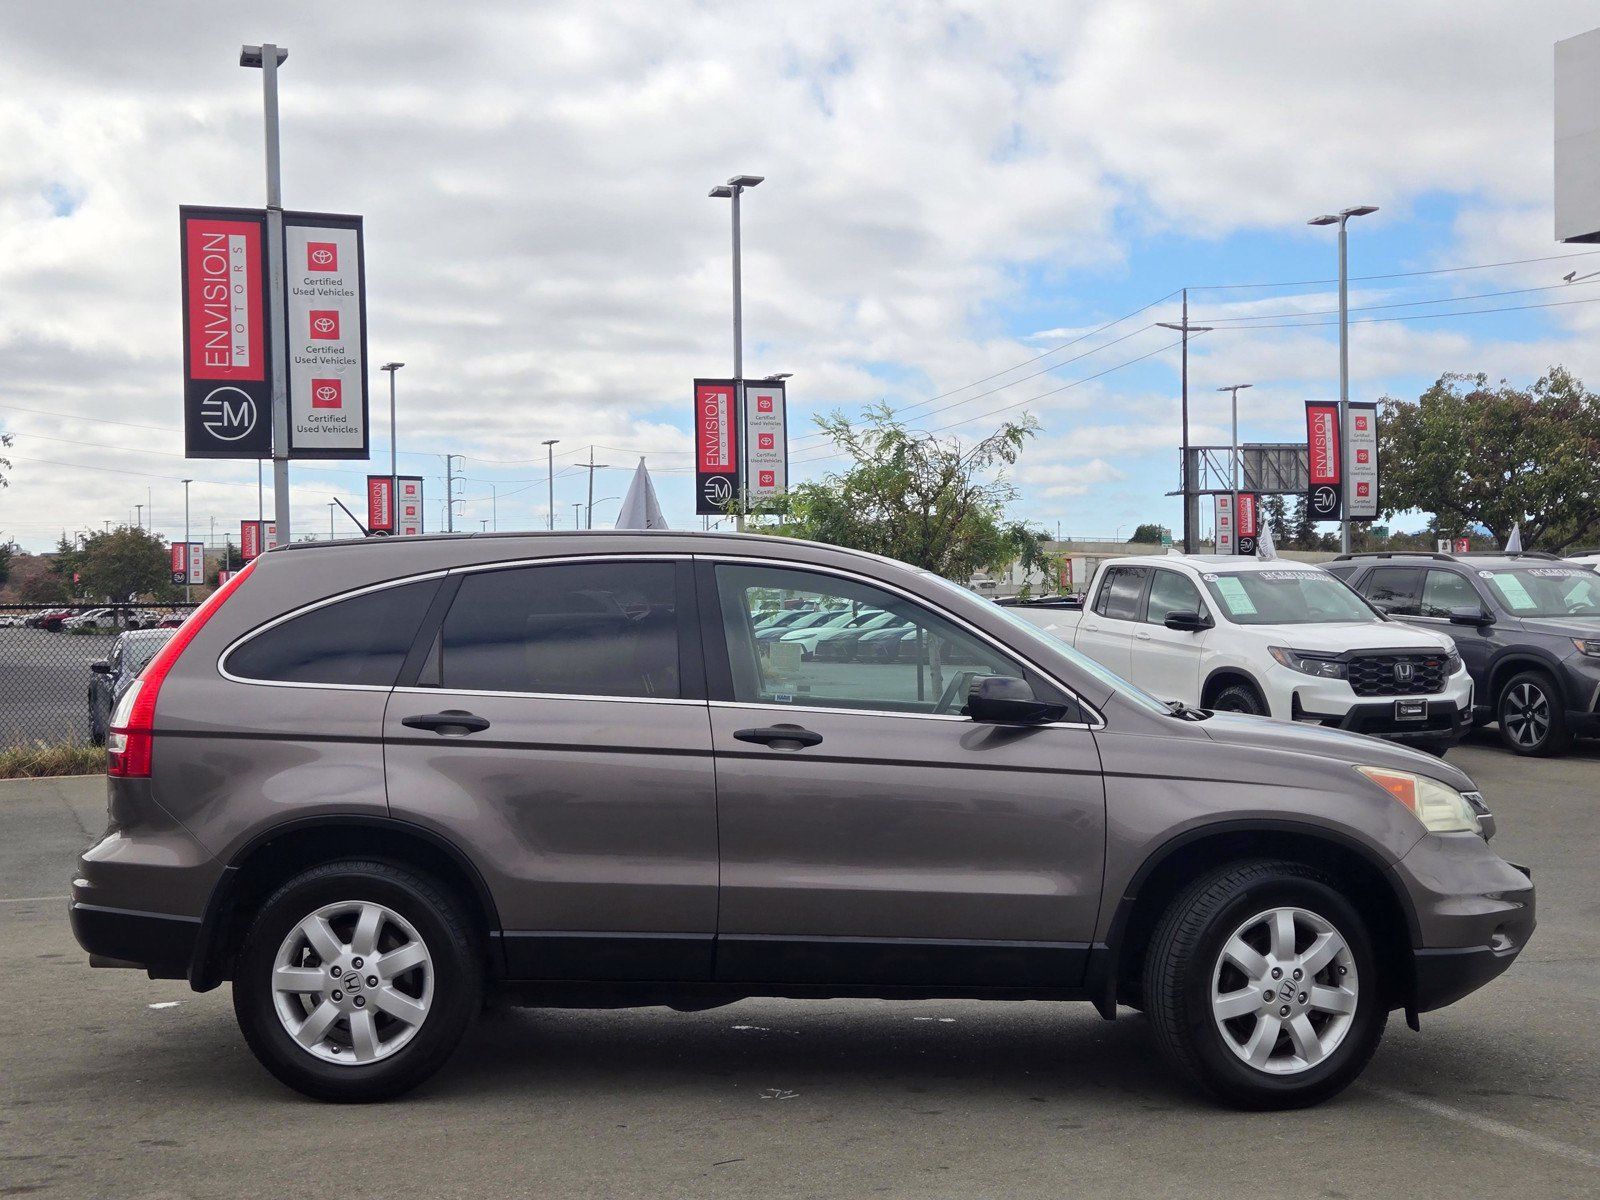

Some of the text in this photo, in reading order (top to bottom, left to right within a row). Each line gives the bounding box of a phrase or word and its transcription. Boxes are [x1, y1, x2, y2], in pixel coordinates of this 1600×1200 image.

[303, 277, 343, 286] Certified
[292, 288, 355, 297] Used Vehicles
[202, 233, 229, 367] ENVISION
[232, 246, 246, 356] MOTORS
[305, 346, 345, 354] Certified
[294, 356, 357, 365] Used Vehicles
[308, 414, 347, 423] Certified
[296, 425, 359, 434] Used Vehicles
[705, 392, 719, 466] ENVISION
[1314, 412, 1327, 478] ENVISION
[373, 482, 382, 526] ENVISION
